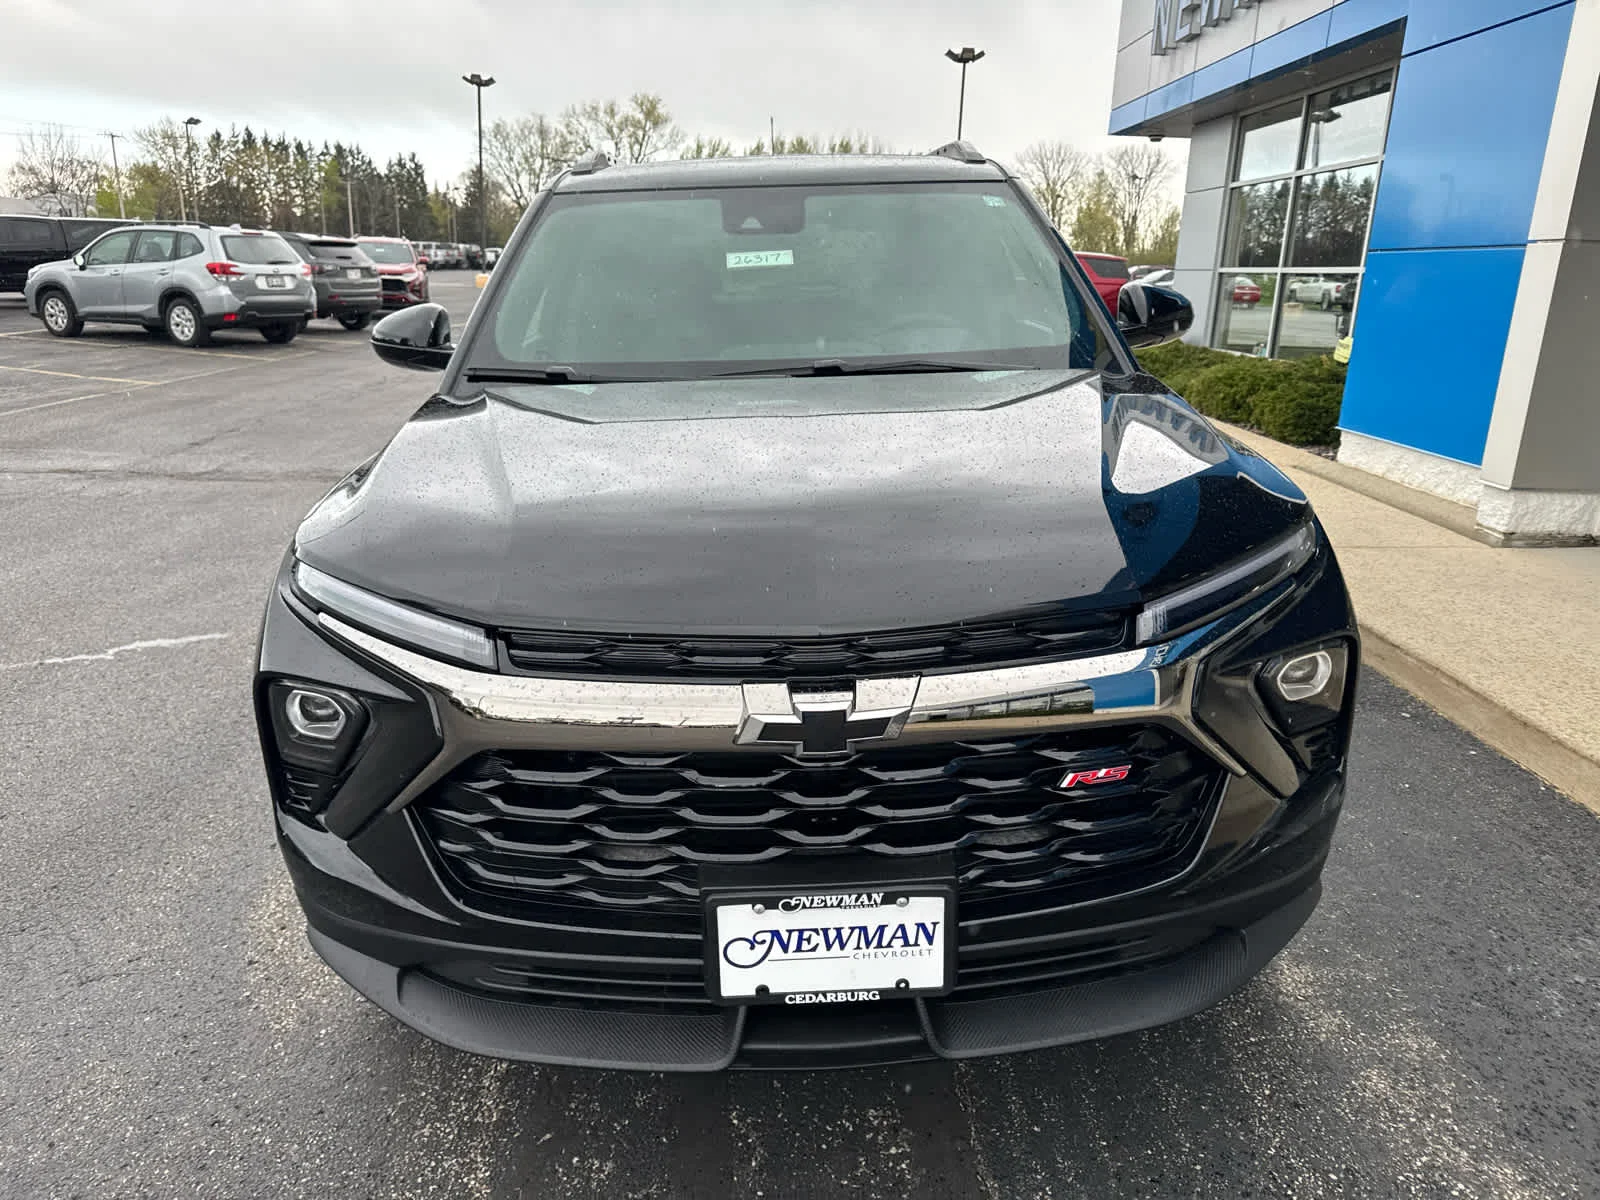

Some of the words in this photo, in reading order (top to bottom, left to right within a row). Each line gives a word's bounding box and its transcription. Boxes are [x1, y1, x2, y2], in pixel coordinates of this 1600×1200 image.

[733, 252, 781, 265] 26317
[1058, 764, 1132, 788] RS
[778, 892, 885, 913] NEWMAN
[722, 921, 940, 969] NEWMAN
[853, 948, 934, 960] CHEVROLET
[785, 990, 881, 1005] CEDARBURG
